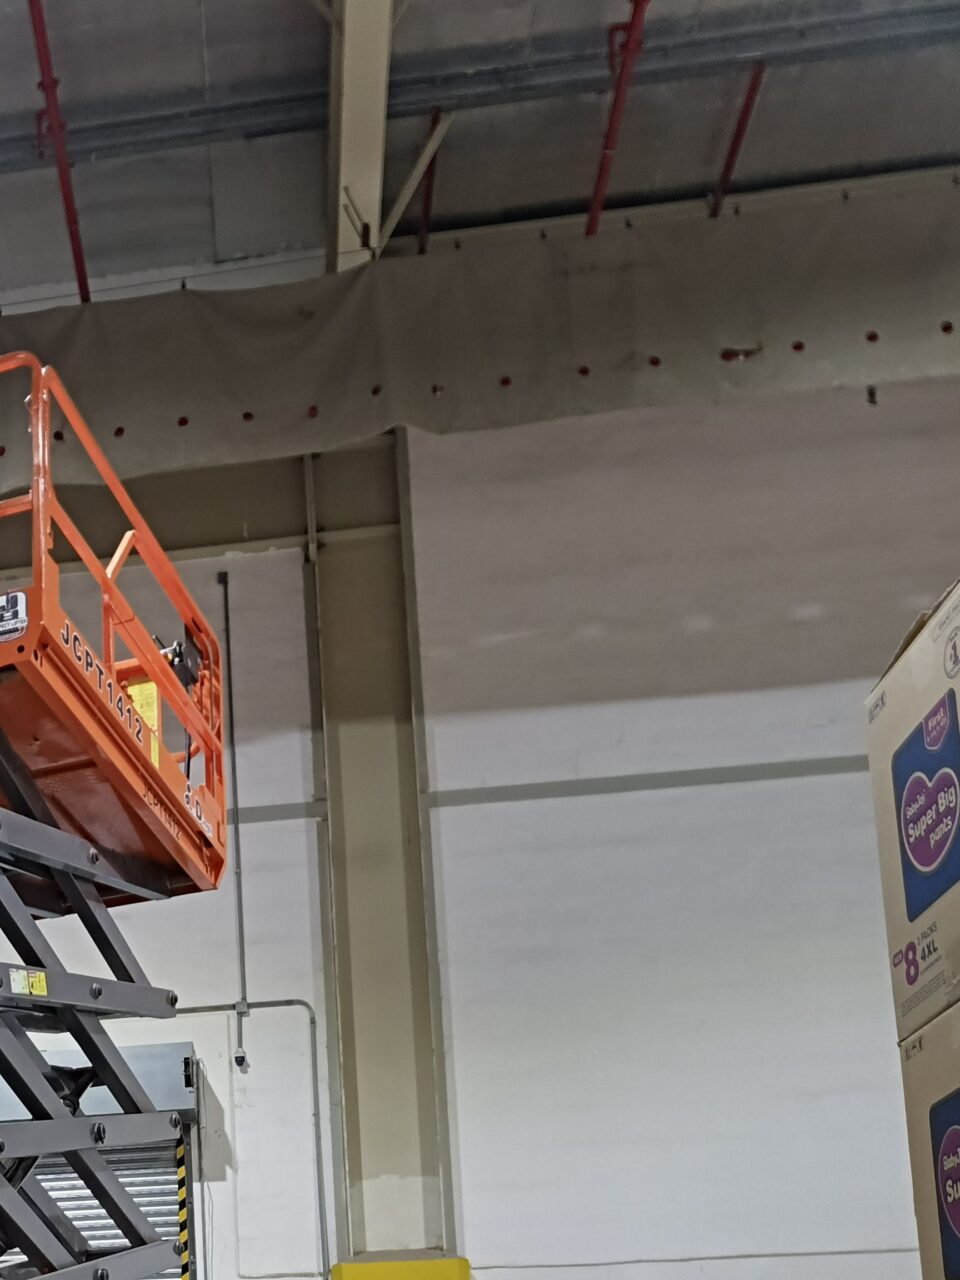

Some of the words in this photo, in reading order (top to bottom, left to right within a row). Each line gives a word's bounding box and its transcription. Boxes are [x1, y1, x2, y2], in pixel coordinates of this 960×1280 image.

[60, 620, 144, 746] JCPT1412
[907, 804, 937, 844] Super
[937, 784, 956, 814] Big
[928, 815, 952, 850] pants
[904, 940, 920, 986] 8
[920, 938, 939, 961] 4XL
